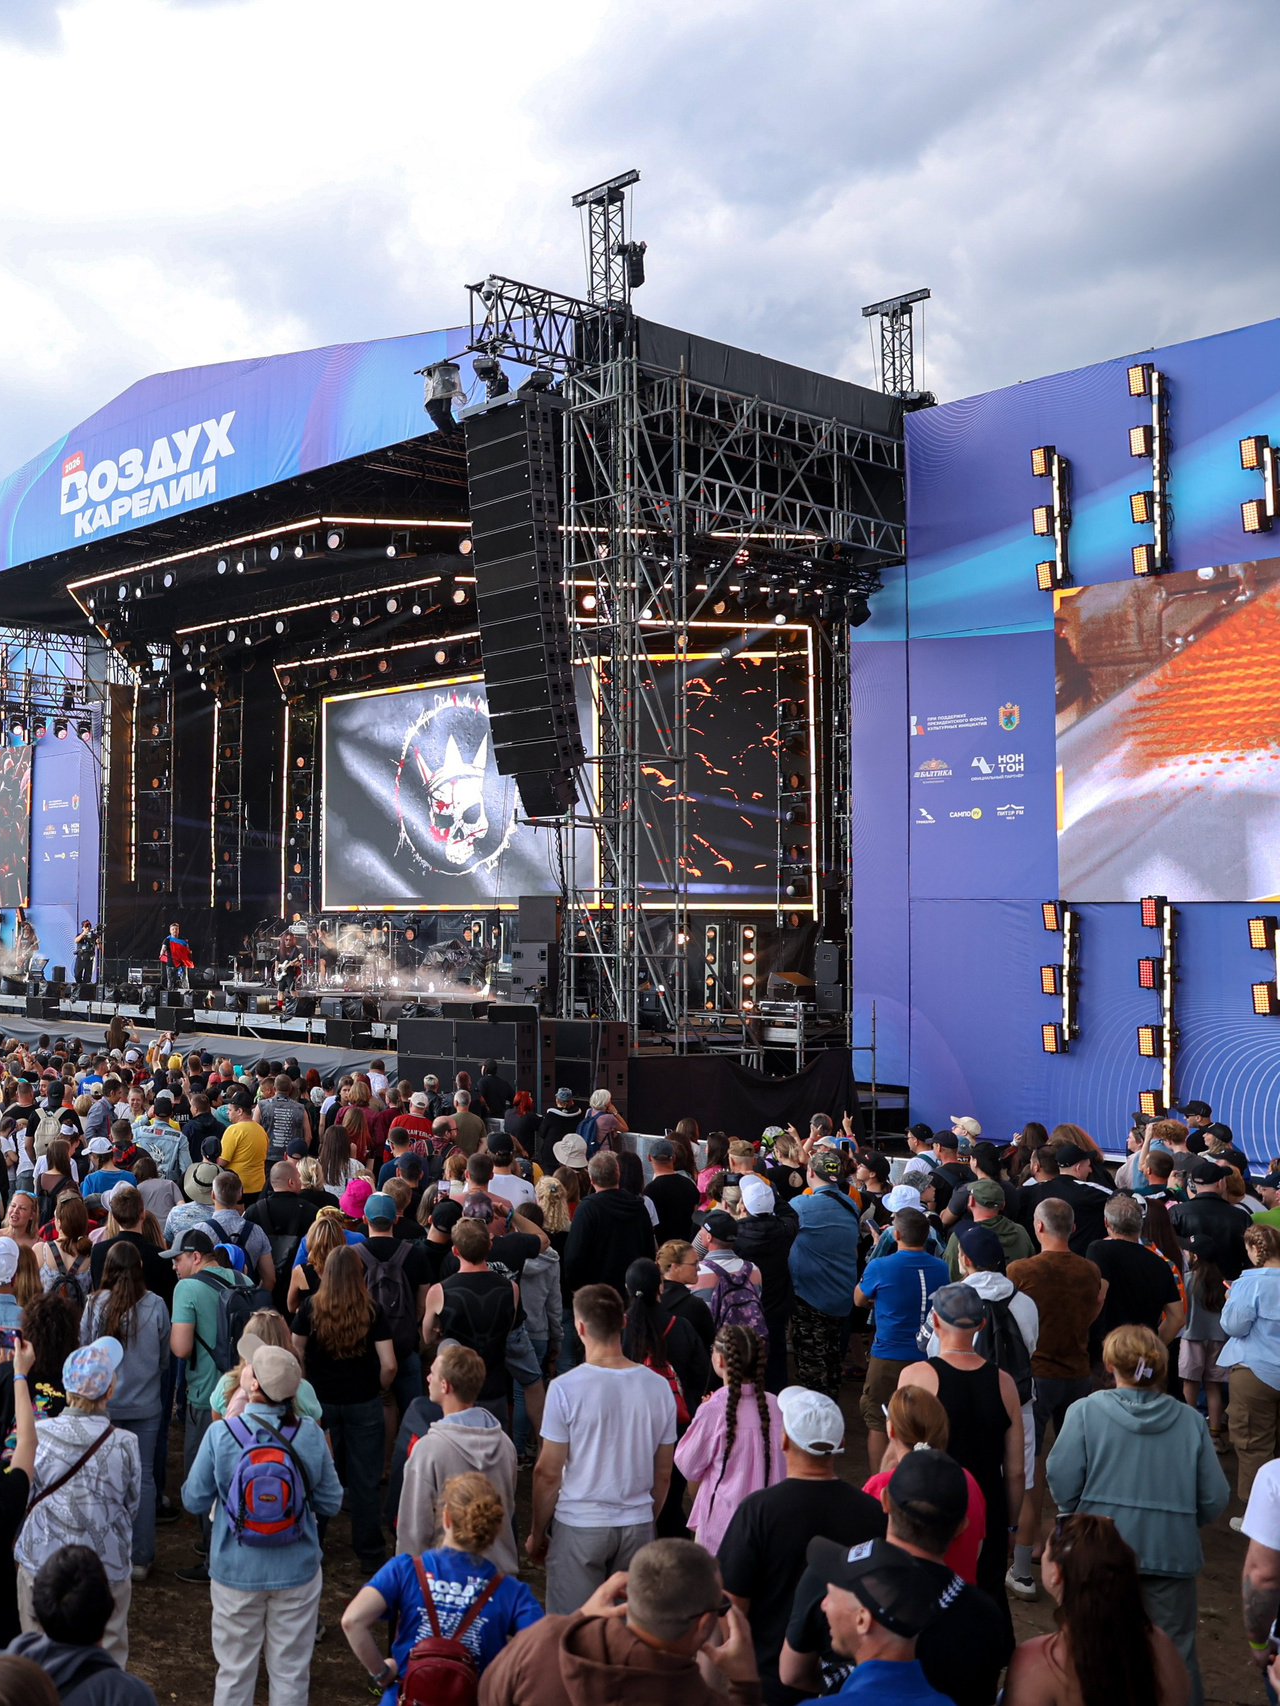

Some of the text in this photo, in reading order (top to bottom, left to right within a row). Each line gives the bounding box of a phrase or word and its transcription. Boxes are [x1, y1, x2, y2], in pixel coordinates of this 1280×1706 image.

[60, 410, 236, 515] ВОЗДУХ
[64, 456, 81, 474] 2026
[74, 465, 216, 538] КАРЕЛИИ
[927, 718, 969, 726] ПРЕЗИДЕНТСКОГО
[998, 753, 1024, 763] НОН
[998, 763, 1024, 773] ТОН
[920, 769, 953, 778] БАЛТИКА
